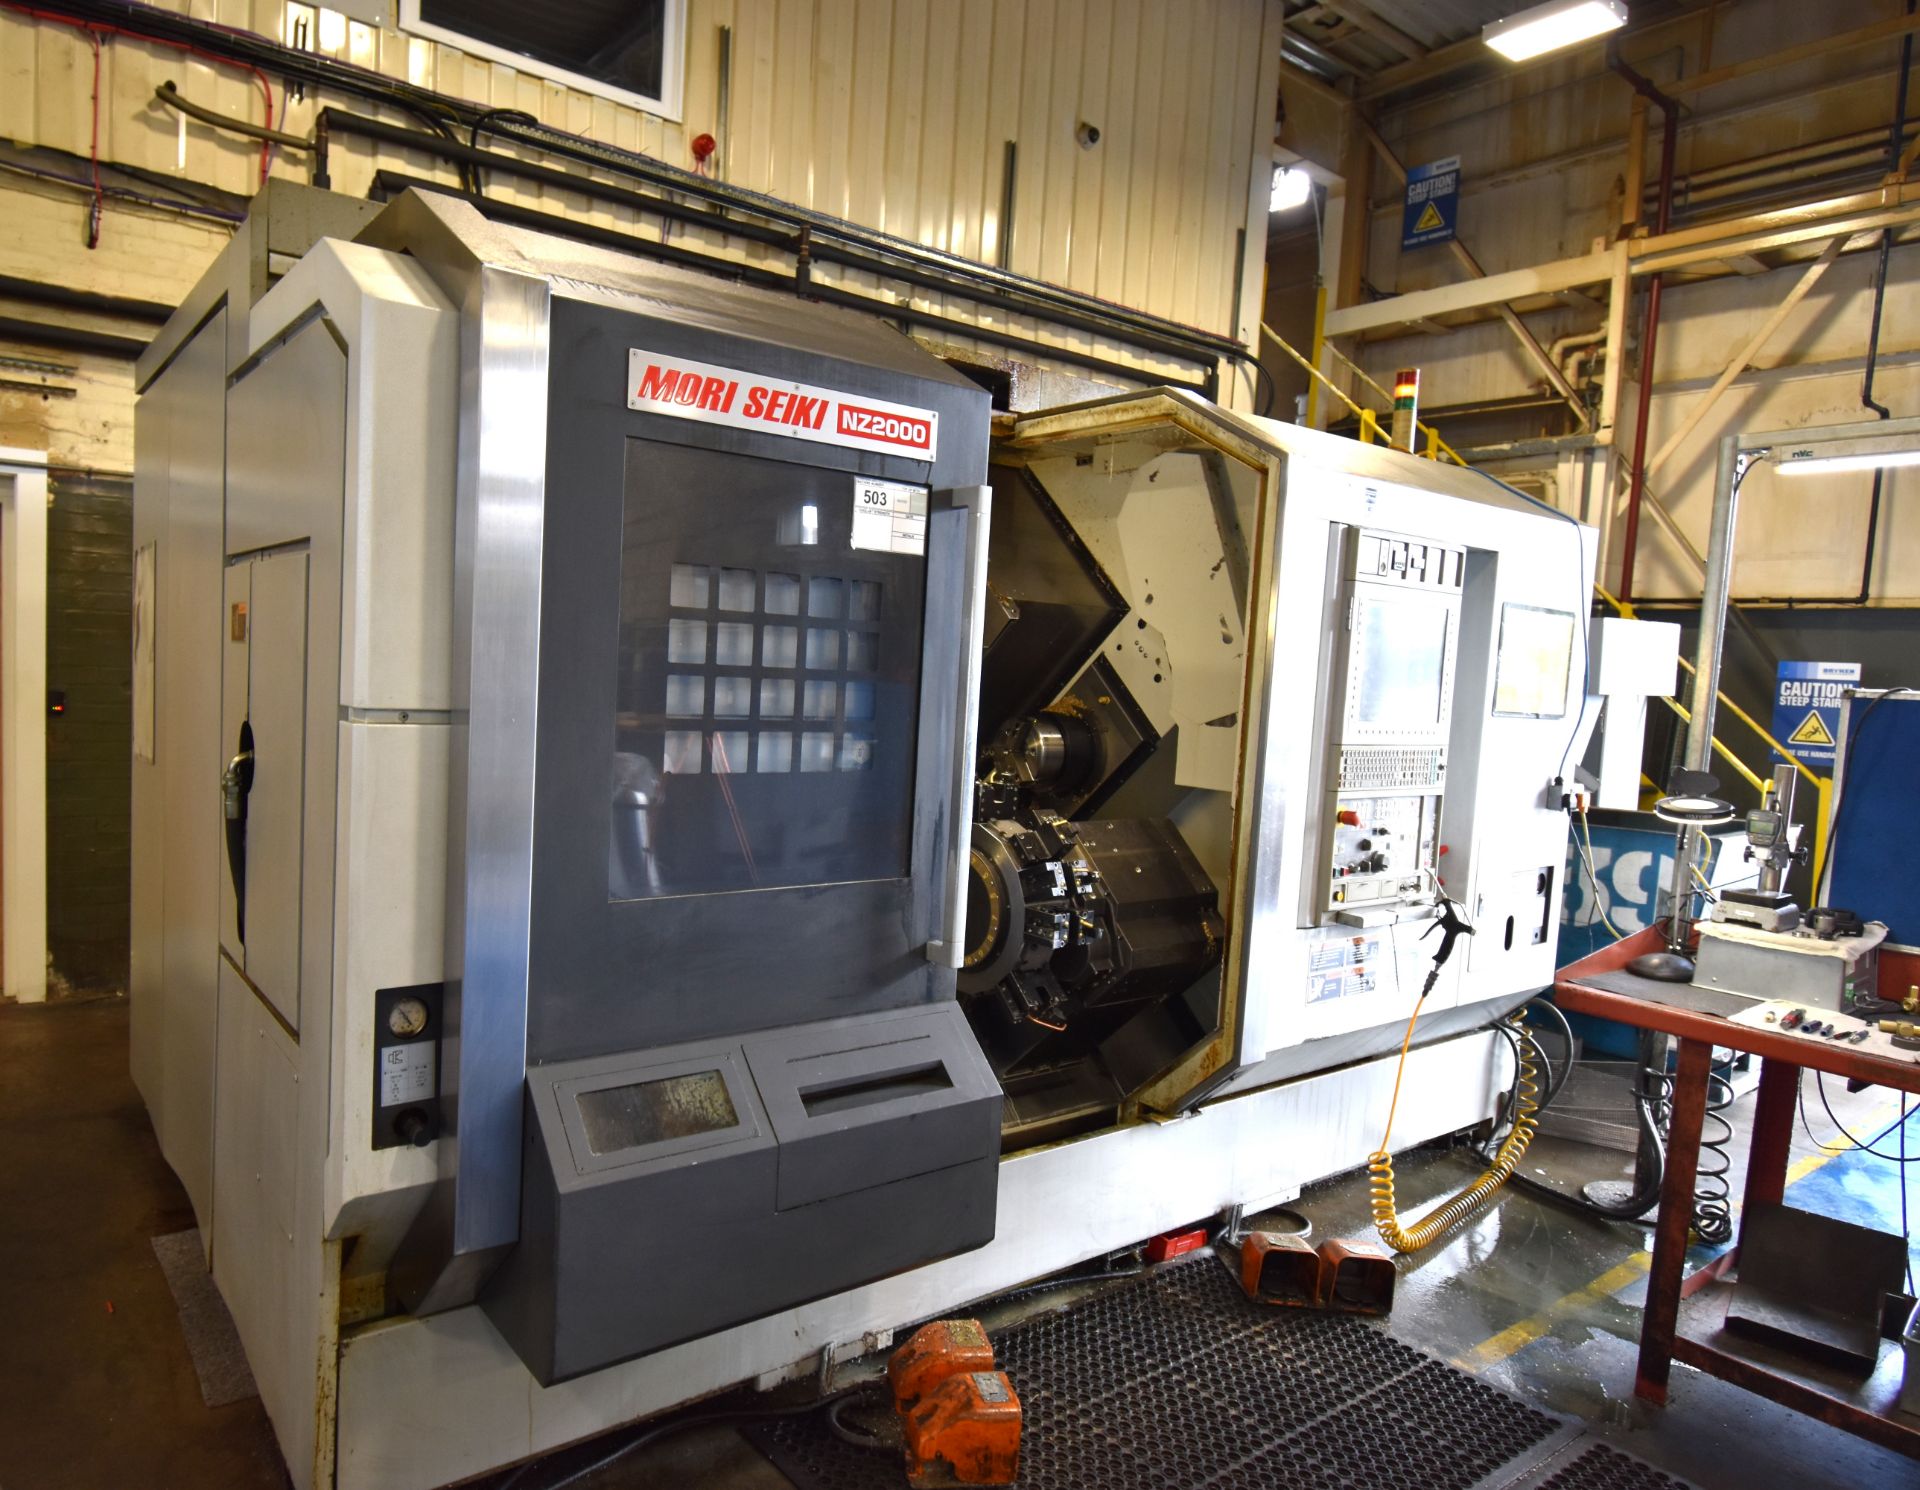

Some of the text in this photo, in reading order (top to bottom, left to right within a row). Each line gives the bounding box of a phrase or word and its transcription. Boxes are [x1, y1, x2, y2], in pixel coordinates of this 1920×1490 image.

[1408, 172, 1456, 196] CAUTION!
[638, 365, 829, 430] MORI SEIKI
[842, 410, 927, 444] NZ2000
[864, 490, 887, 506] 503
[1779, 696, 1841, 708] STEEP STAIR
